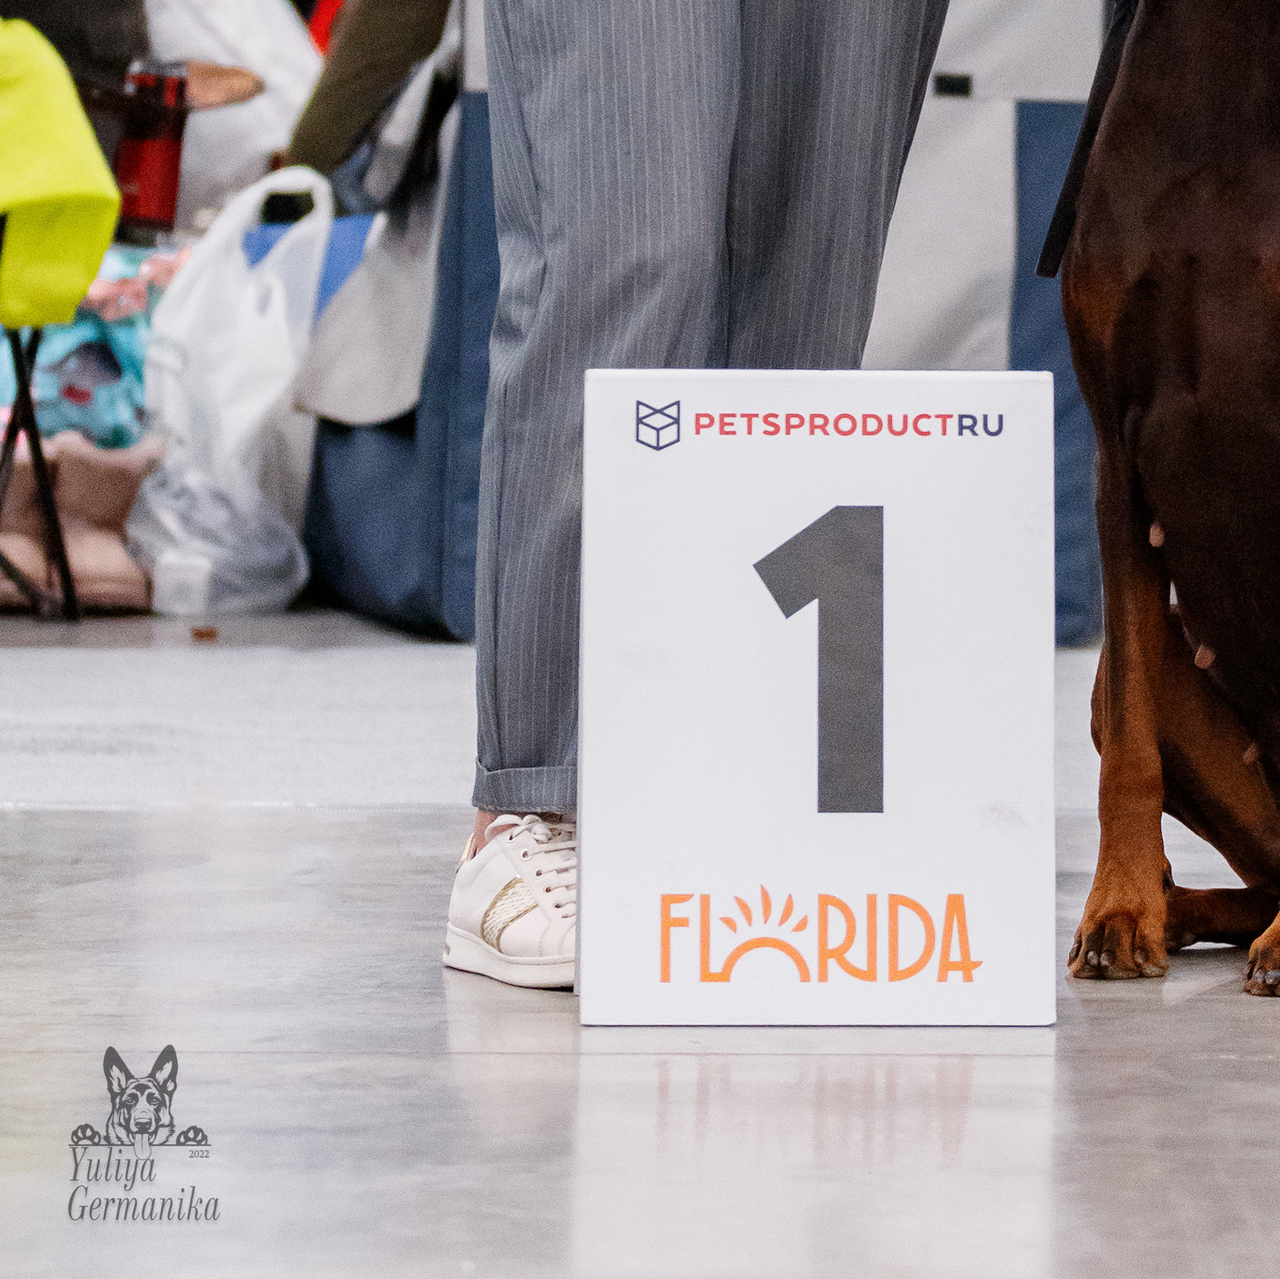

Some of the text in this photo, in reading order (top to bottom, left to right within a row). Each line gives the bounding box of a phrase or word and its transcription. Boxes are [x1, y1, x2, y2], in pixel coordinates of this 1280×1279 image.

[694, 412, 1004, 437] PETSPRODUCTRU
[752, 505, 884, 814] 1
[660, 884, 983, 983] FLORIDA
